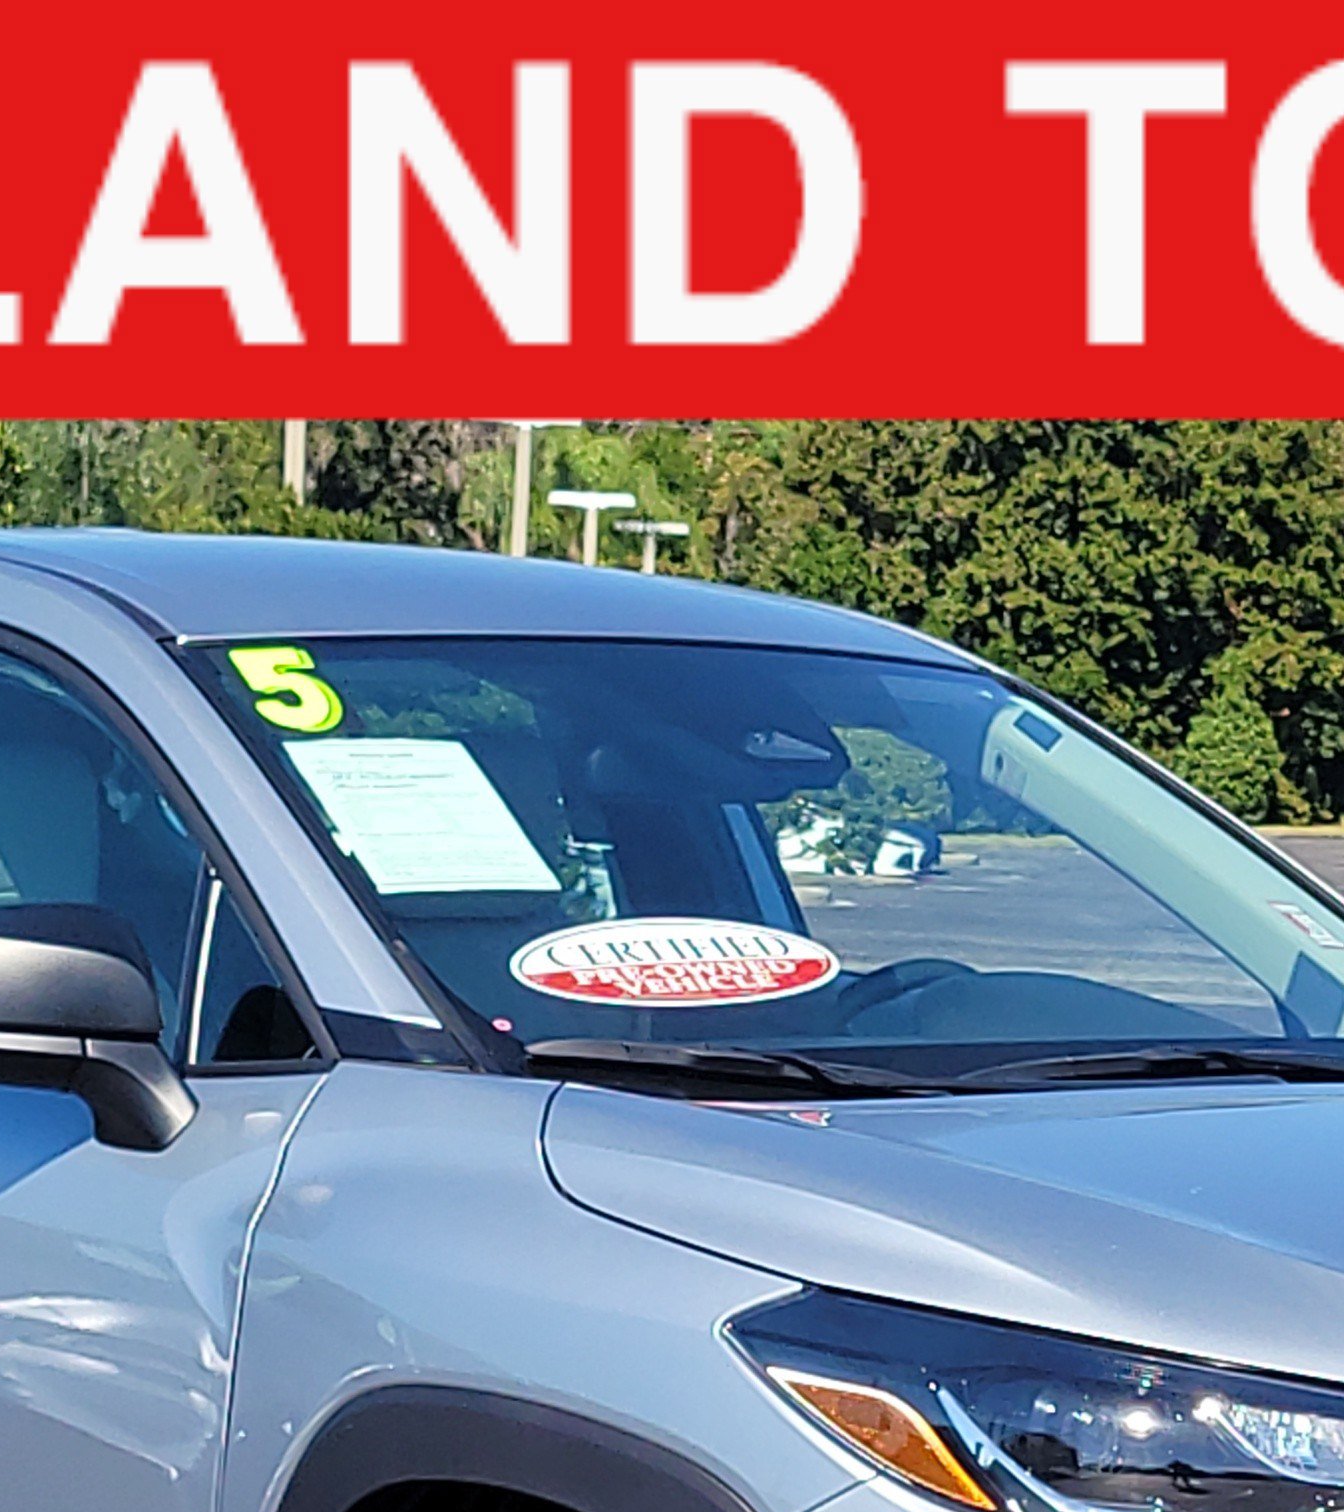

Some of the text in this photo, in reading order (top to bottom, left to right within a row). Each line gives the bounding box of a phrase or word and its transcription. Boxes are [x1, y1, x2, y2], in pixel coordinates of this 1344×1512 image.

[227, 646, 344, 734] 5
[546, 935, 789, 968] CERTIFIED
[568, 958, 798, 987] PRE-OWNED
[614, 969, 781, 997] VEHICLE
